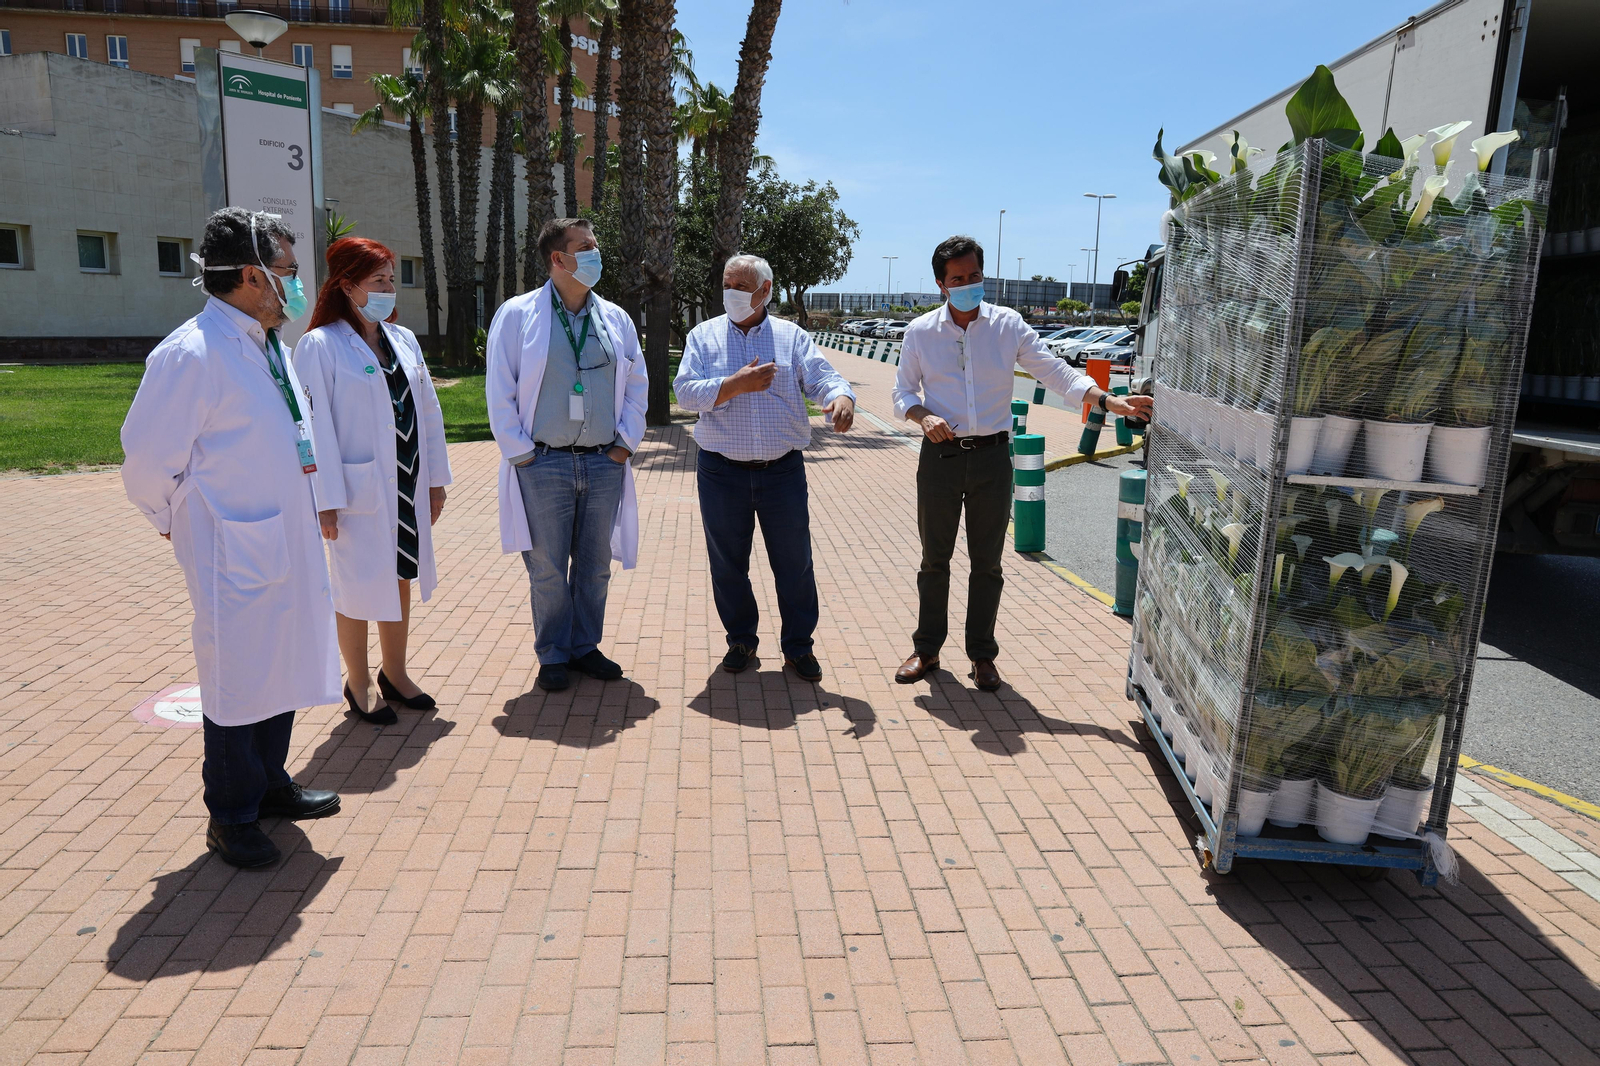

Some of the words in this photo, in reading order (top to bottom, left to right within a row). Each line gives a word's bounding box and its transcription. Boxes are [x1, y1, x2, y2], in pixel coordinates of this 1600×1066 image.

[258, 89, 276, 98] Hospital
[284, 94, 302, 102] Poniente
[259, 138, 285, 148] EDIFICIO
[287, 144, 304, 171] 3
[262, 196, 298, 206] CONSULTAS
[262, 206, 294, 215] EXTERNAS
